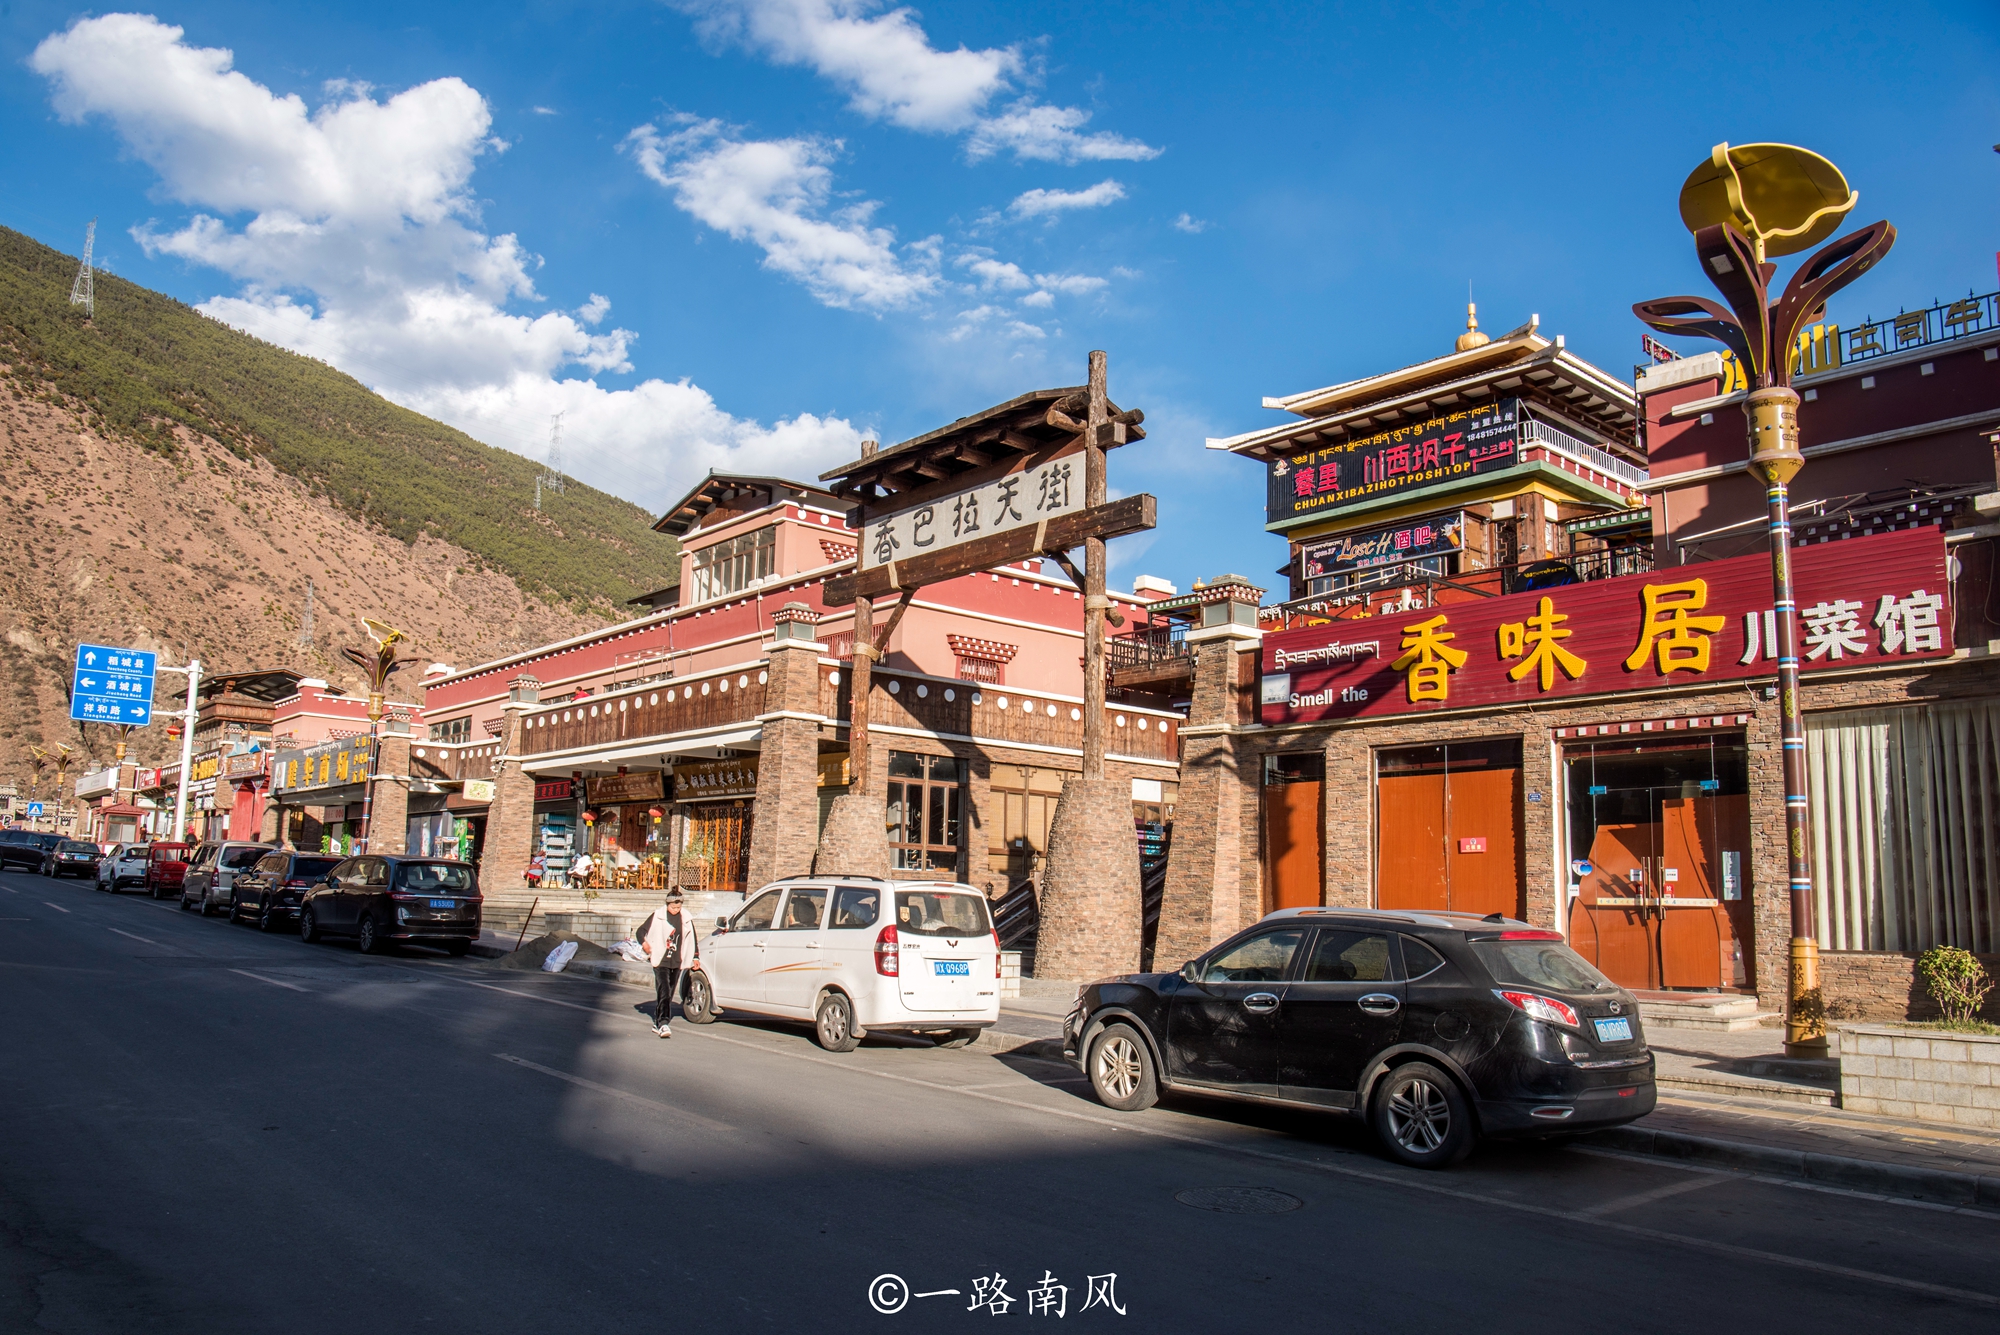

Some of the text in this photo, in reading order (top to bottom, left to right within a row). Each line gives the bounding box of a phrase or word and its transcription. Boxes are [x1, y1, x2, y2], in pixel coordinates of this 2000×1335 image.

[1849, 295, 2000, 356] 土司牛
[1467, 423, 1517, 441] 18481574444
[1294, 431, 1466, 497] 蓉里 川西坝子
[1294, 461, 1471, 511] CHUANXIBAZIHOTPOSHTOP
[872, 463, 1072, 564] 香巴拉天街
[1337, 537, 1377, 561] Lost
[1394, 526, 1431, 550] 酒吧
[1391, 577, 1943, 703] 香味居 川菜馆
[107, 655, 145, 669] 稻城县
[105, 680, 143, 693] 酒城路
[1288, 685, 1368, 708] Smell the
[83, 702, 121, 715] 祥和路
[472, 782, 489, 795] 药
